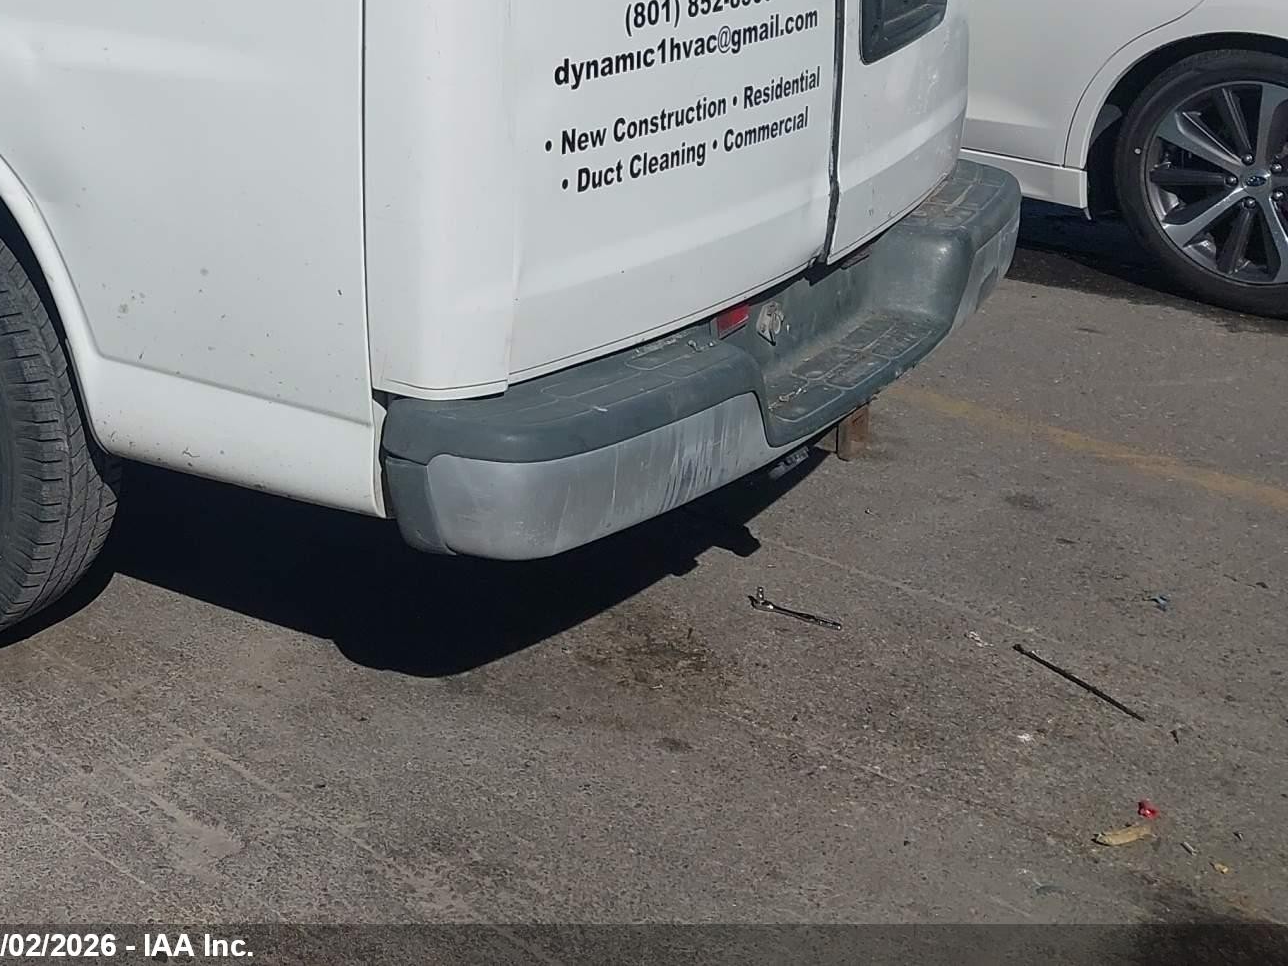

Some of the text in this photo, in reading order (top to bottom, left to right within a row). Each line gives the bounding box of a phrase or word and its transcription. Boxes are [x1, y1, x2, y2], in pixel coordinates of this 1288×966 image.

[554, 9, 818, 90] dynamic1hvac@gmail.com
[561, 66, 821, 155] New Construction Residential
[577, 105, 809, 193] Duct Cleaning Commercial
